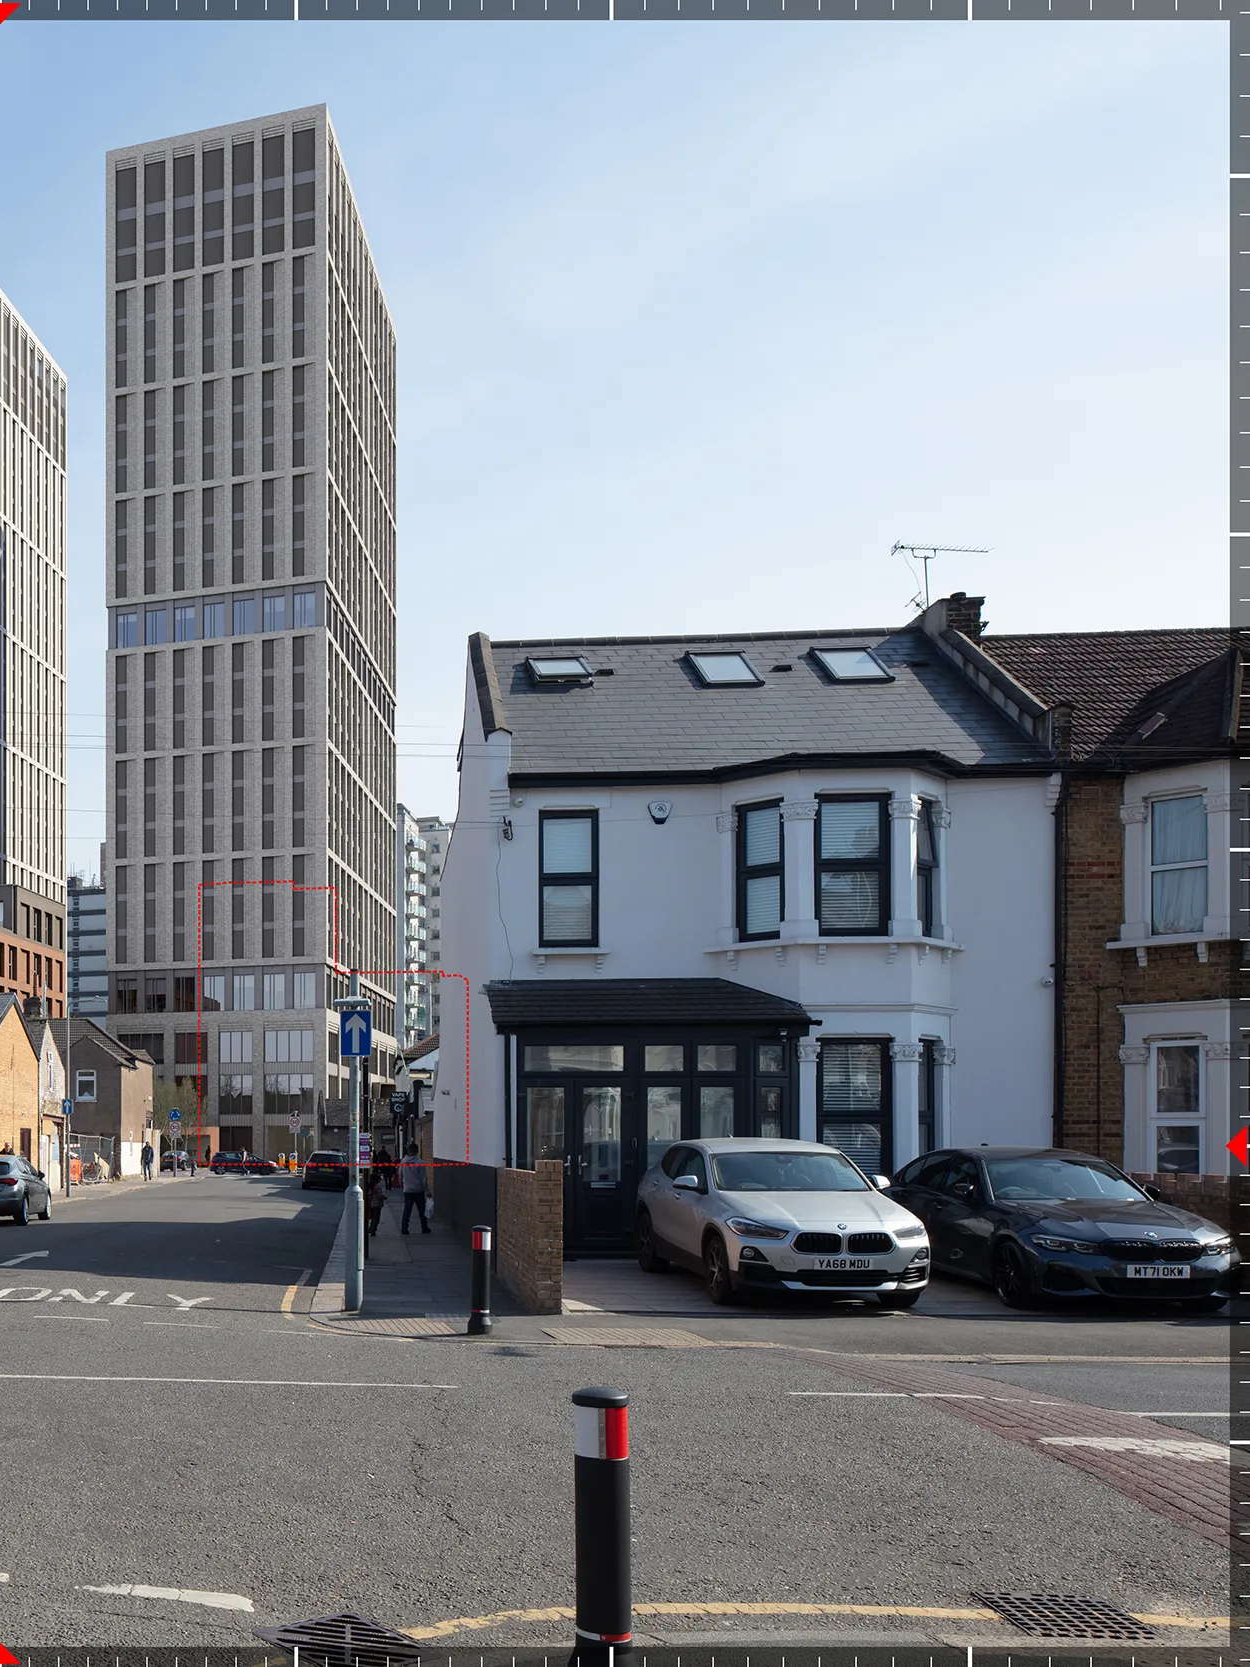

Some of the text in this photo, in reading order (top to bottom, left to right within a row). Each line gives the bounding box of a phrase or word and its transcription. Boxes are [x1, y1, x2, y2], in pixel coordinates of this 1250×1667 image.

[818, 1259, 870, 1269] YA68 MDU
[1134, 1266, 1184, 1277] MT71 OKW
